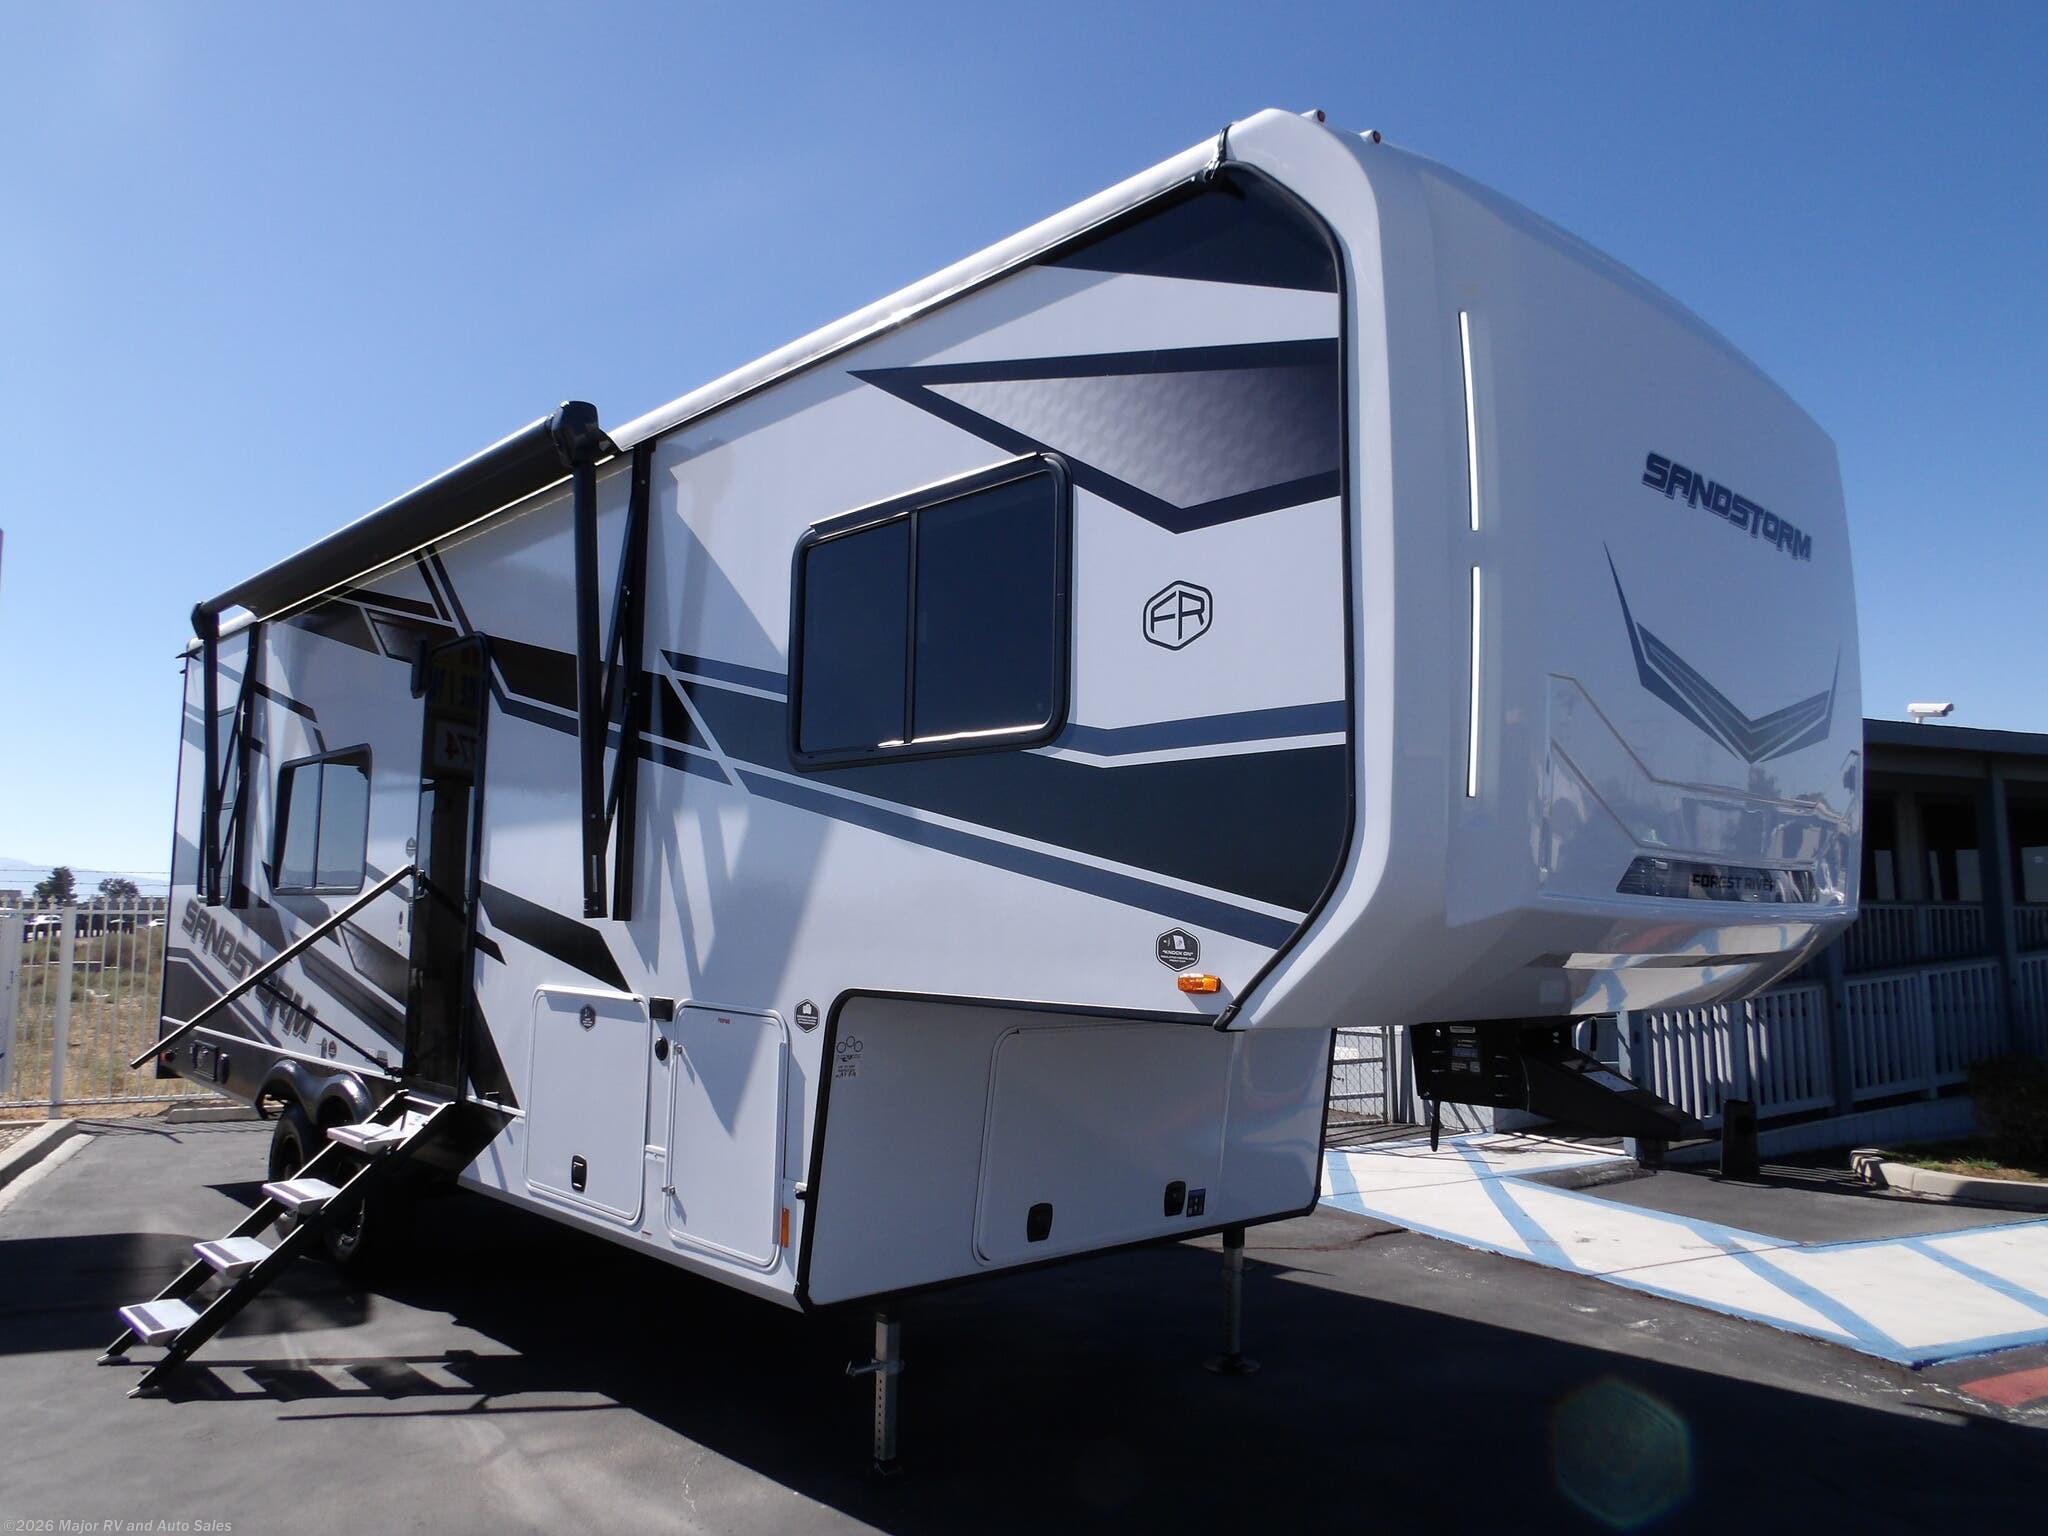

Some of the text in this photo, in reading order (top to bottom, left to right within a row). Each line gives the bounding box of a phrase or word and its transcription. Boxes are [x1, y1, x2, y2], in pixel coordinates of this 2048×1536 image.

[1641, 452, 1812, 562] SANDSTORM
[1150, 589, 1205, 641] FR
[1692, 873, 1776, 892] FOREST RIVER
